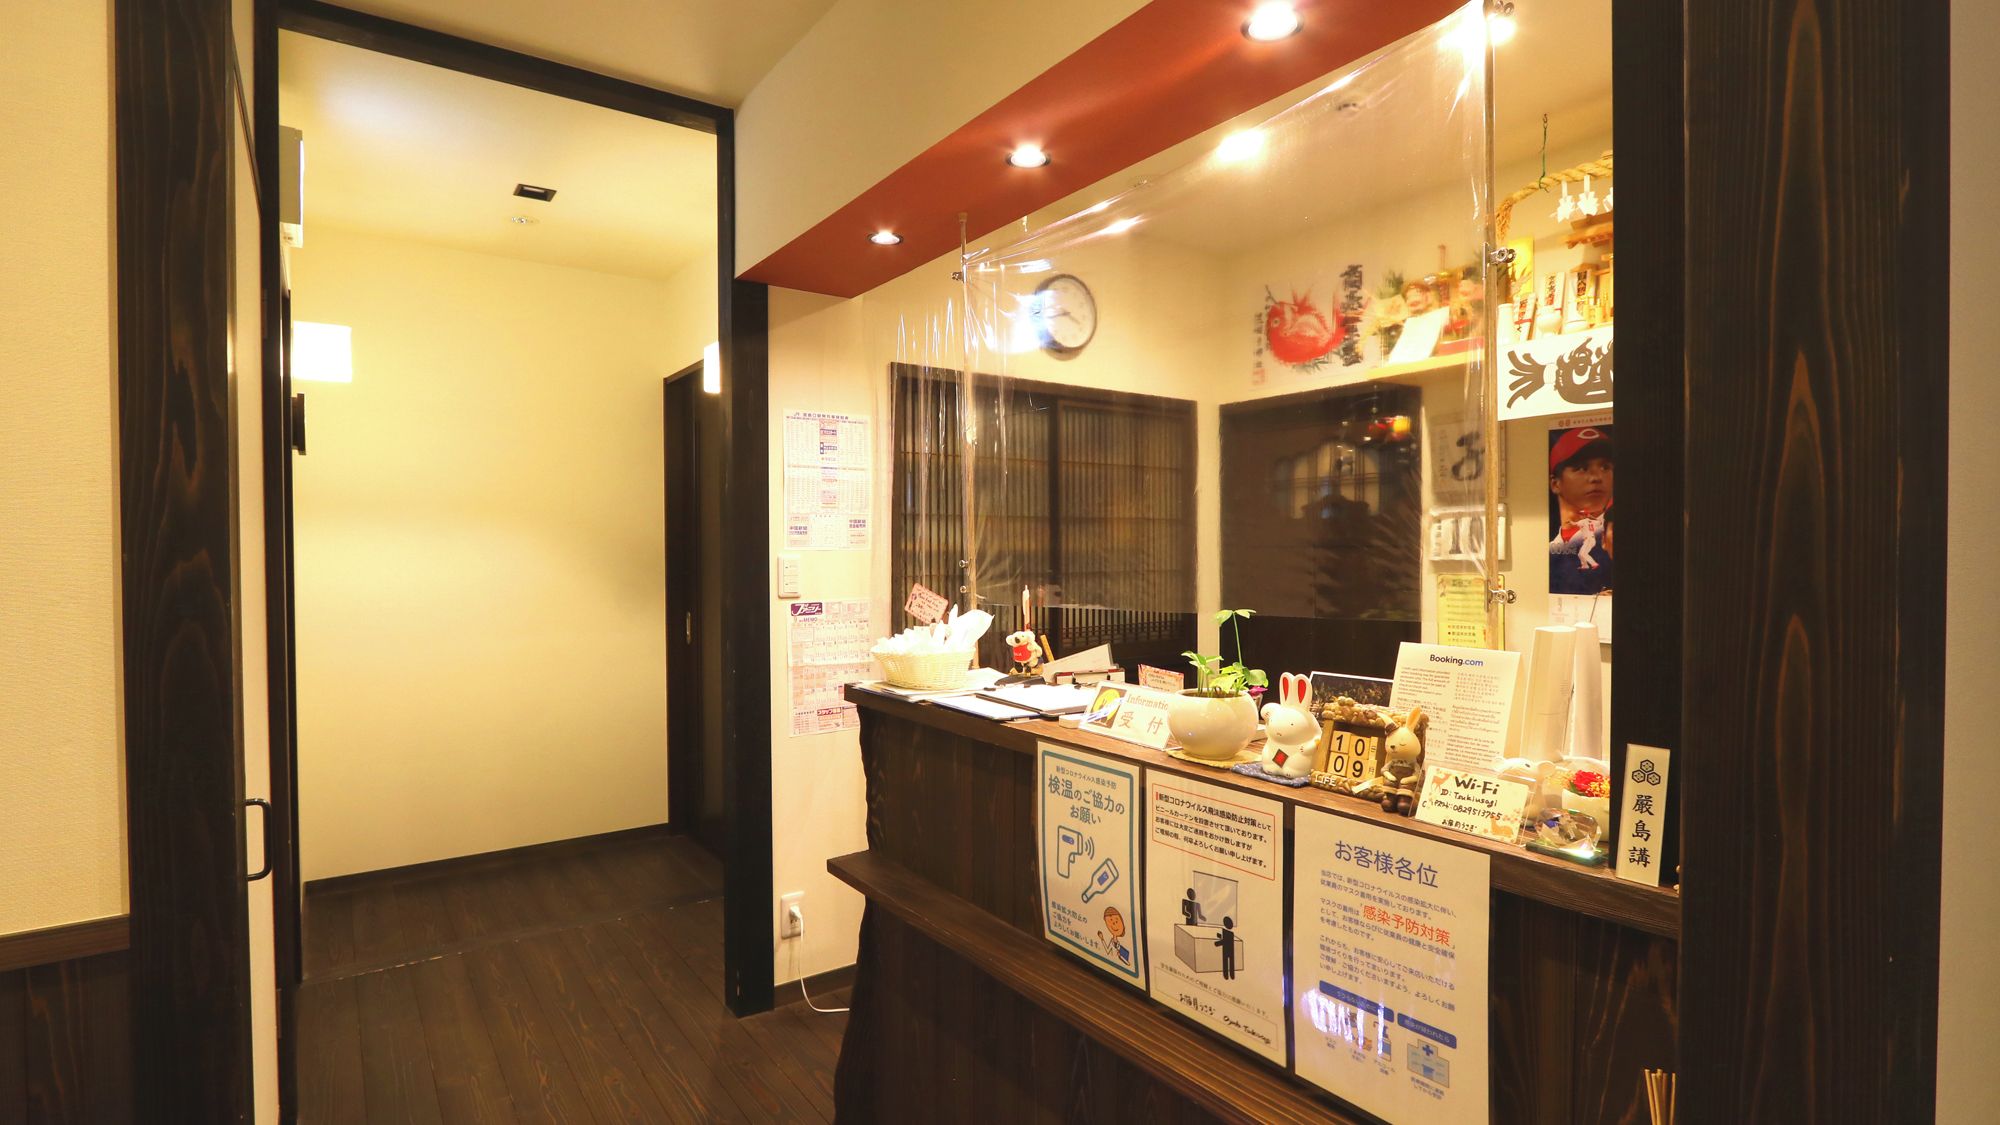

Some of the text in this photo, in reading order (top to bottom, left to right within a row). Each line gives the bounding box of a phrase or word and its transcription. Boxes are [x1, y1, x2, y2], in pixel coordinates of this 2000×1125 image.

[1429, 654, 1484, 666] Booking.com
[1119, 711, 1163, 735] 受付
[1336, 734, 1366, 757] 10
[1333, 755, 1364, 778] 09
[1314, 775, 1337, 787] LIFE
[1454, 775, 1500, 795] Wi-Fi
[1048, 773, 1125, 815] 検温のご協力の
[1070, 804, 1102, 824] お願い
[1334, 840, 1439, 889] お客様各位
